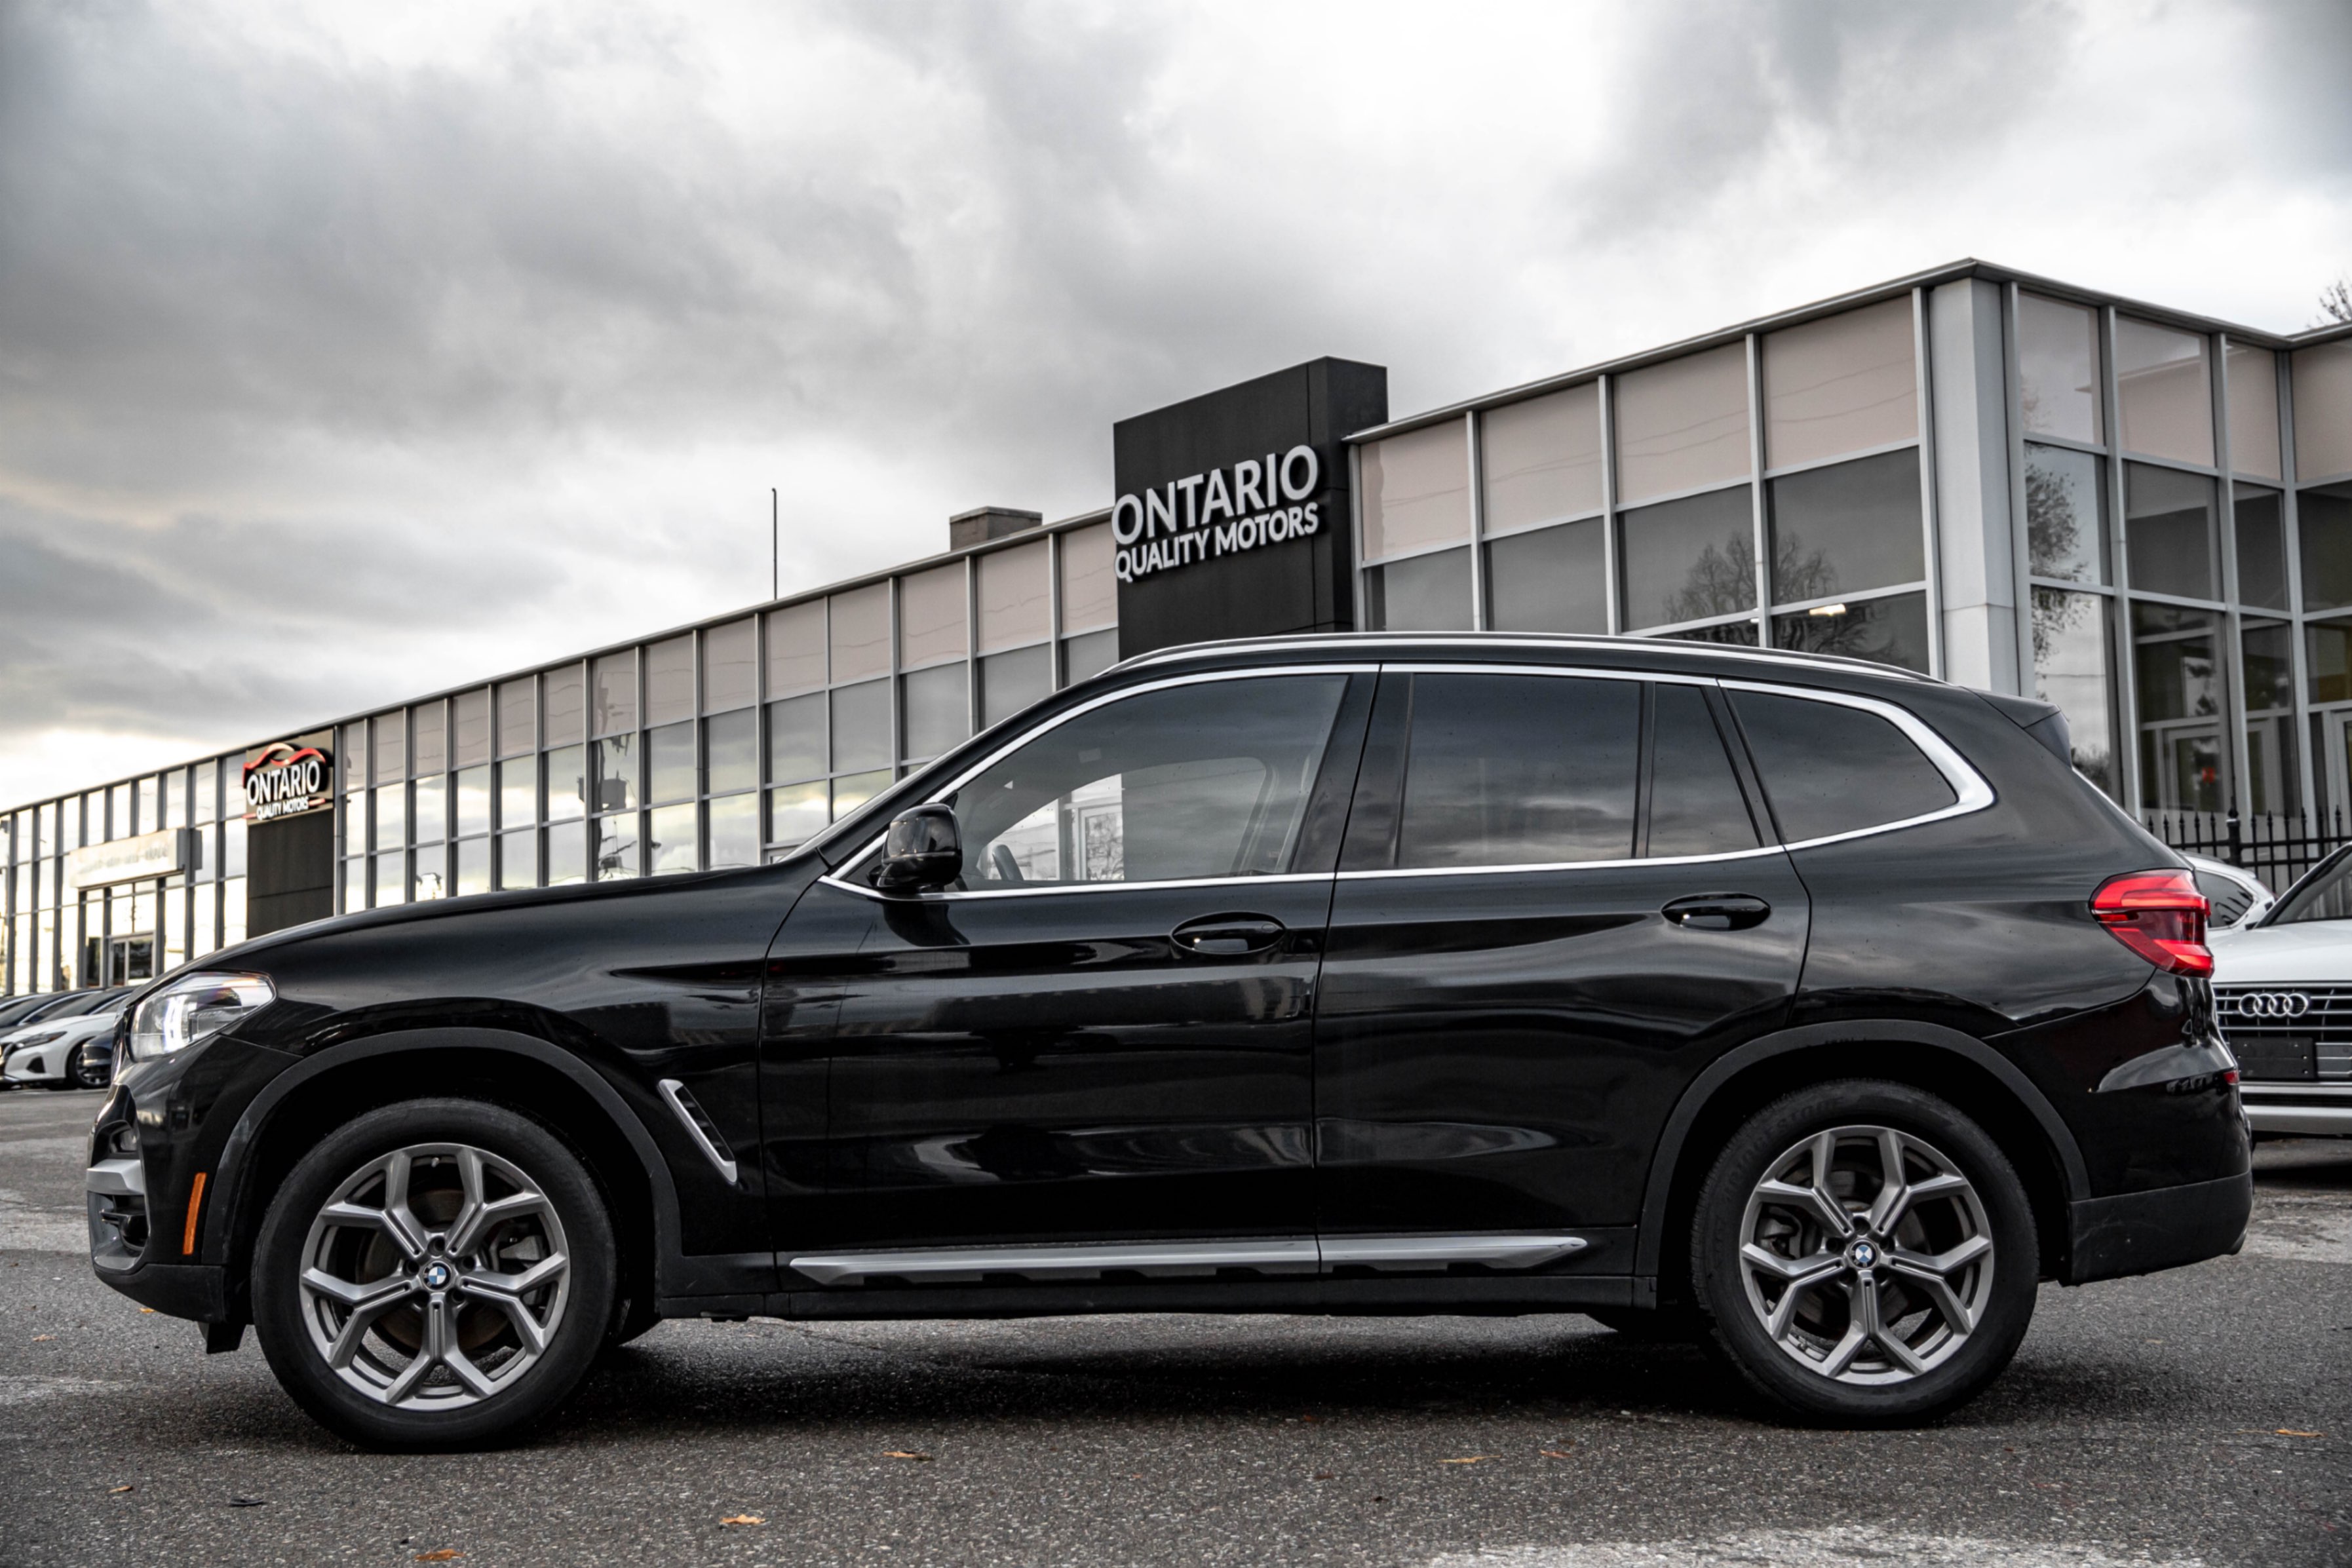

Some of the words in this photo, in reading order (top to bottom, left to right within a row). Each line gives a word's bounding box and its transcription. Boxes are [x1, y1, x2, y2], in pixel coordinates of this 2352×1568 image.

[1111, 445, 1318, 545] ONTARIO
[1115, 528, 1210, 583] QUALITY
[1216, 502, 1319, 556] MOTORS
[247, 761, 320, 805] ONTARIO
[257, 801, 282, 820] QUALITY
[282, 795, 309, 814] MOTORS
